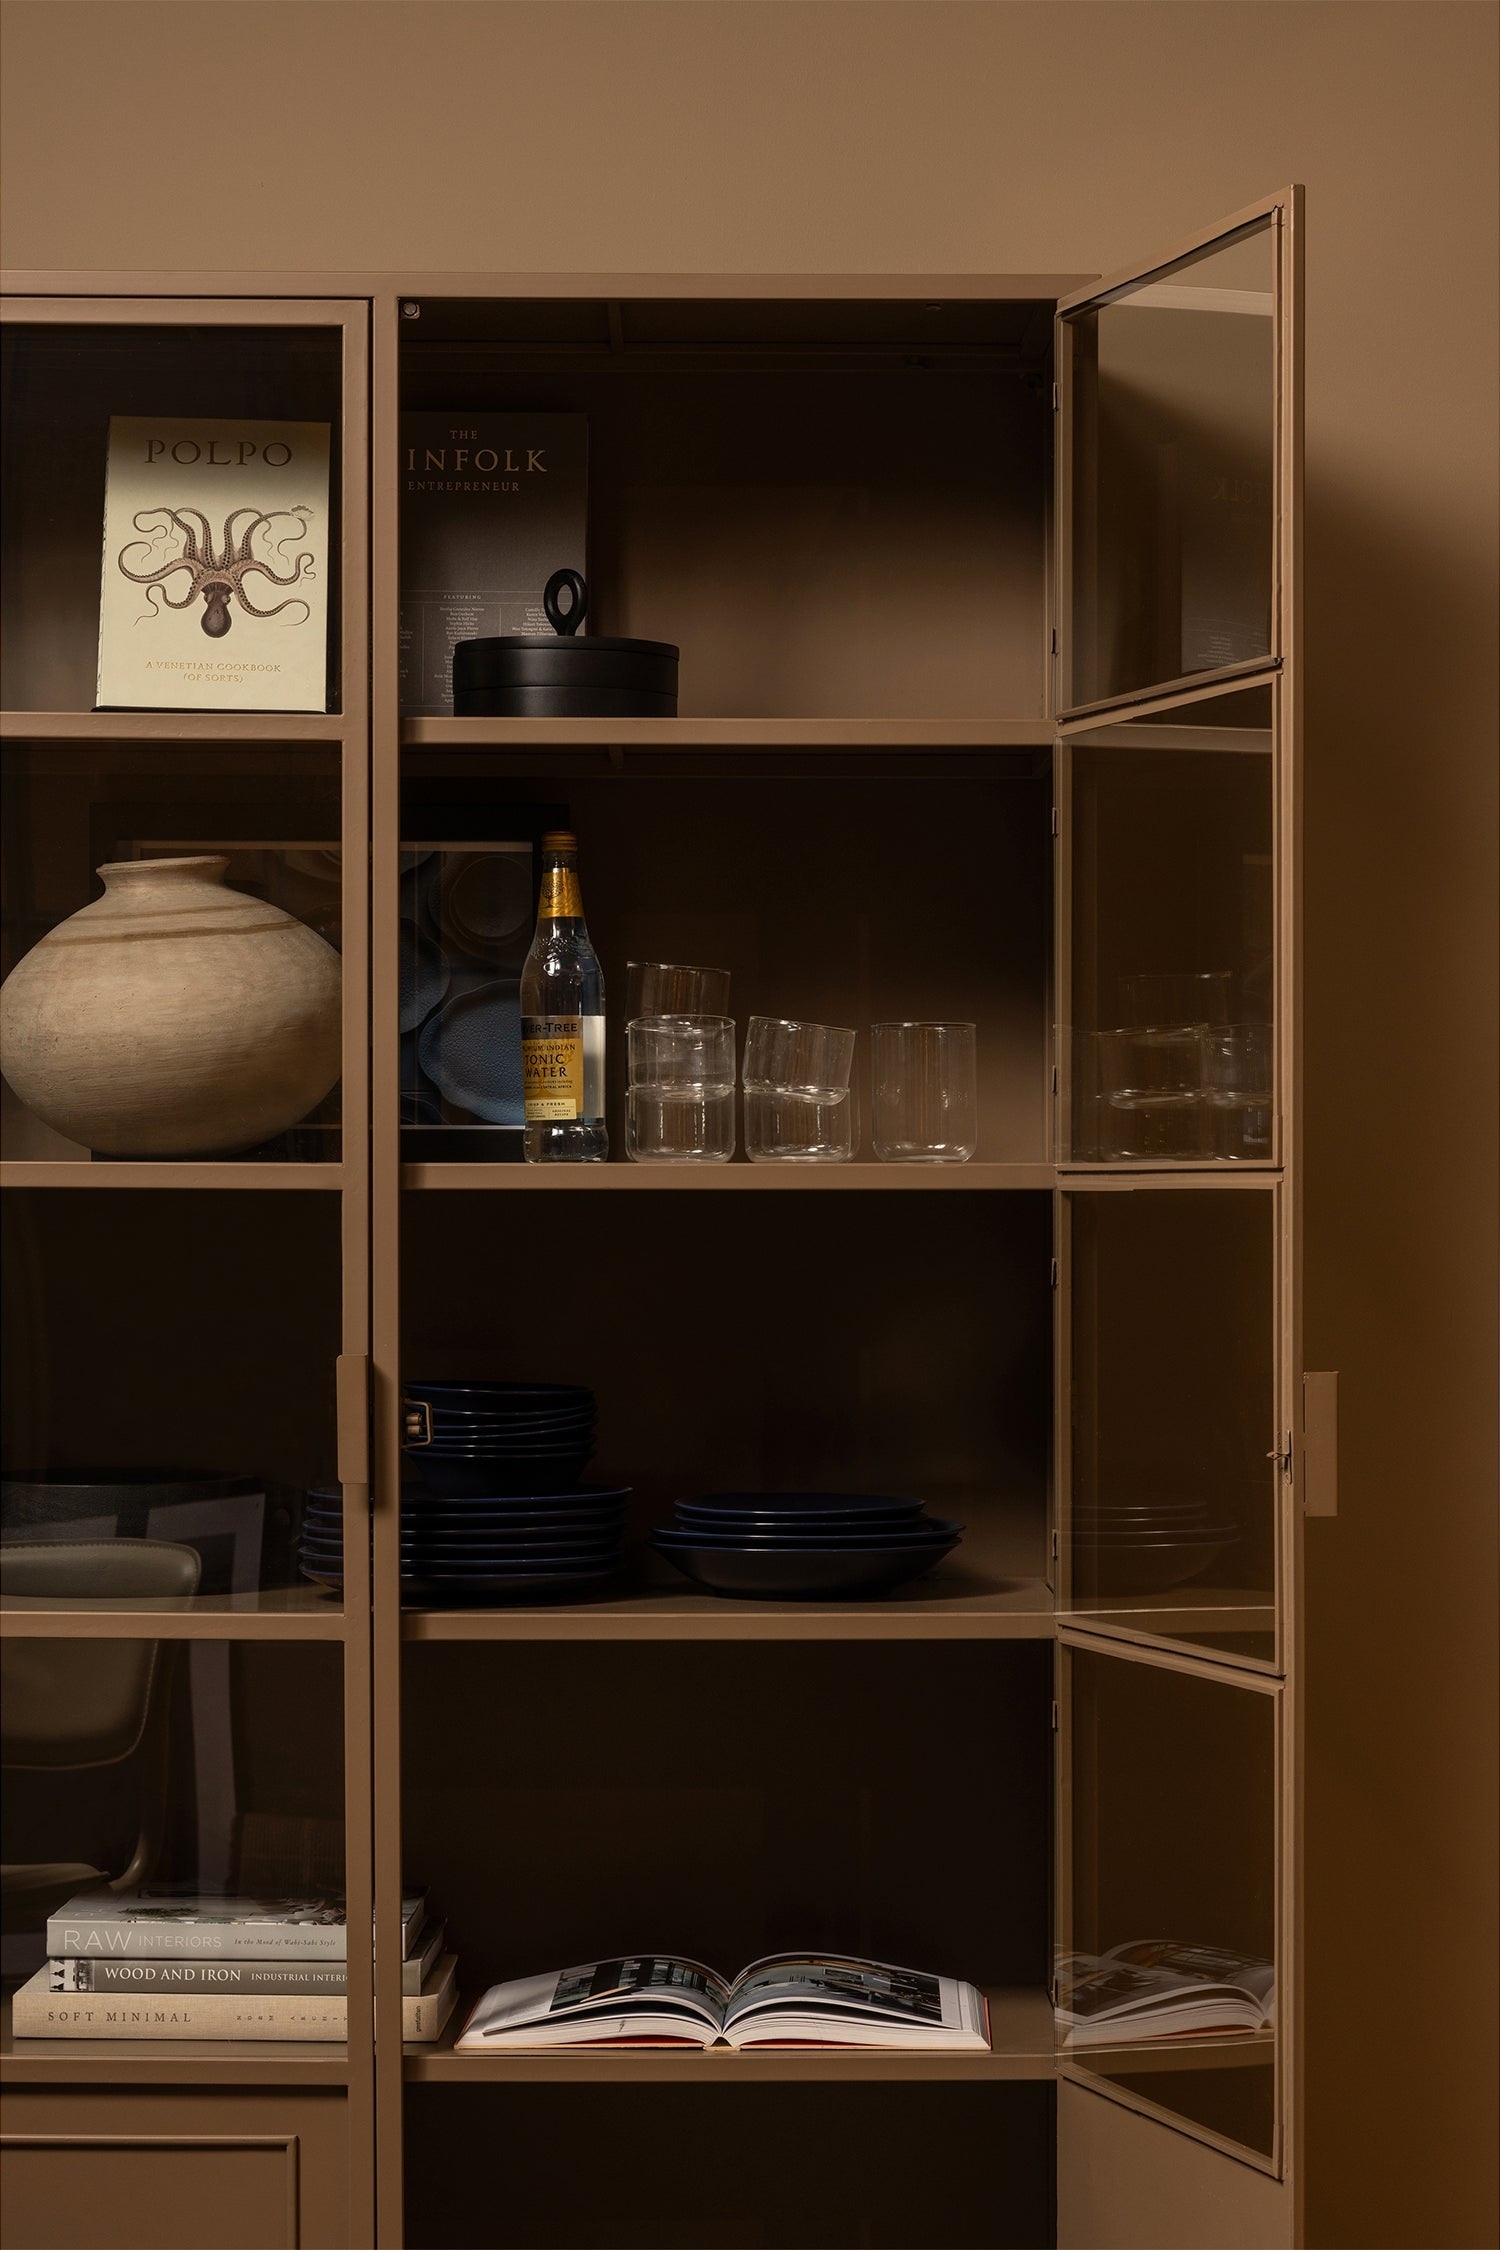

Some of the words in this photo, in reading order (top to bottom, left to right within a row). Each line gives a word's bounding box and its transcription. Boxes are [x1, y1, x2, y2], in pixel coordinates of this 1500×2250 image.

[449, 430, 479, 440] THE
[144, 439, 292, 467] POLPO
[407, 449, 548, 473] INFOLK
[408, 480, 520, 492] ENTREPRENEUR
[145, 661, 153, 669] A
[153, 662, 213, 671] VENETIAN
[217, 663, 281, 673] COOKBOOK
[183, 673, 202, 682] (OF
[205, 674, 244, 683] SORTS)
[526, 1022, 578, 1033] VER-TREE
[525, 1054, 564, 1065] TONIC
[526, 1067, 568, 1077] WATER
[64, 1930, 132, 1951] RAW
[139, 1936, 222, 1949] INTERIORS
[275, 1938, 282, 1946] of
[285, 1938, 317, 1946] Wabi-Sabi
[105, 1967, 156, 1980] WOOD
[160, 1968, 196, 1981] AND
[201, 1969, 242, 1981] IRON
[251, 1973, 310, 1982] INDUSTRIAL
[313, 1973, 348, 1982] INTERI
[48, 2011, 94, 2022] SOFT
[106, 2012, 192, 2023] MINIMAL
